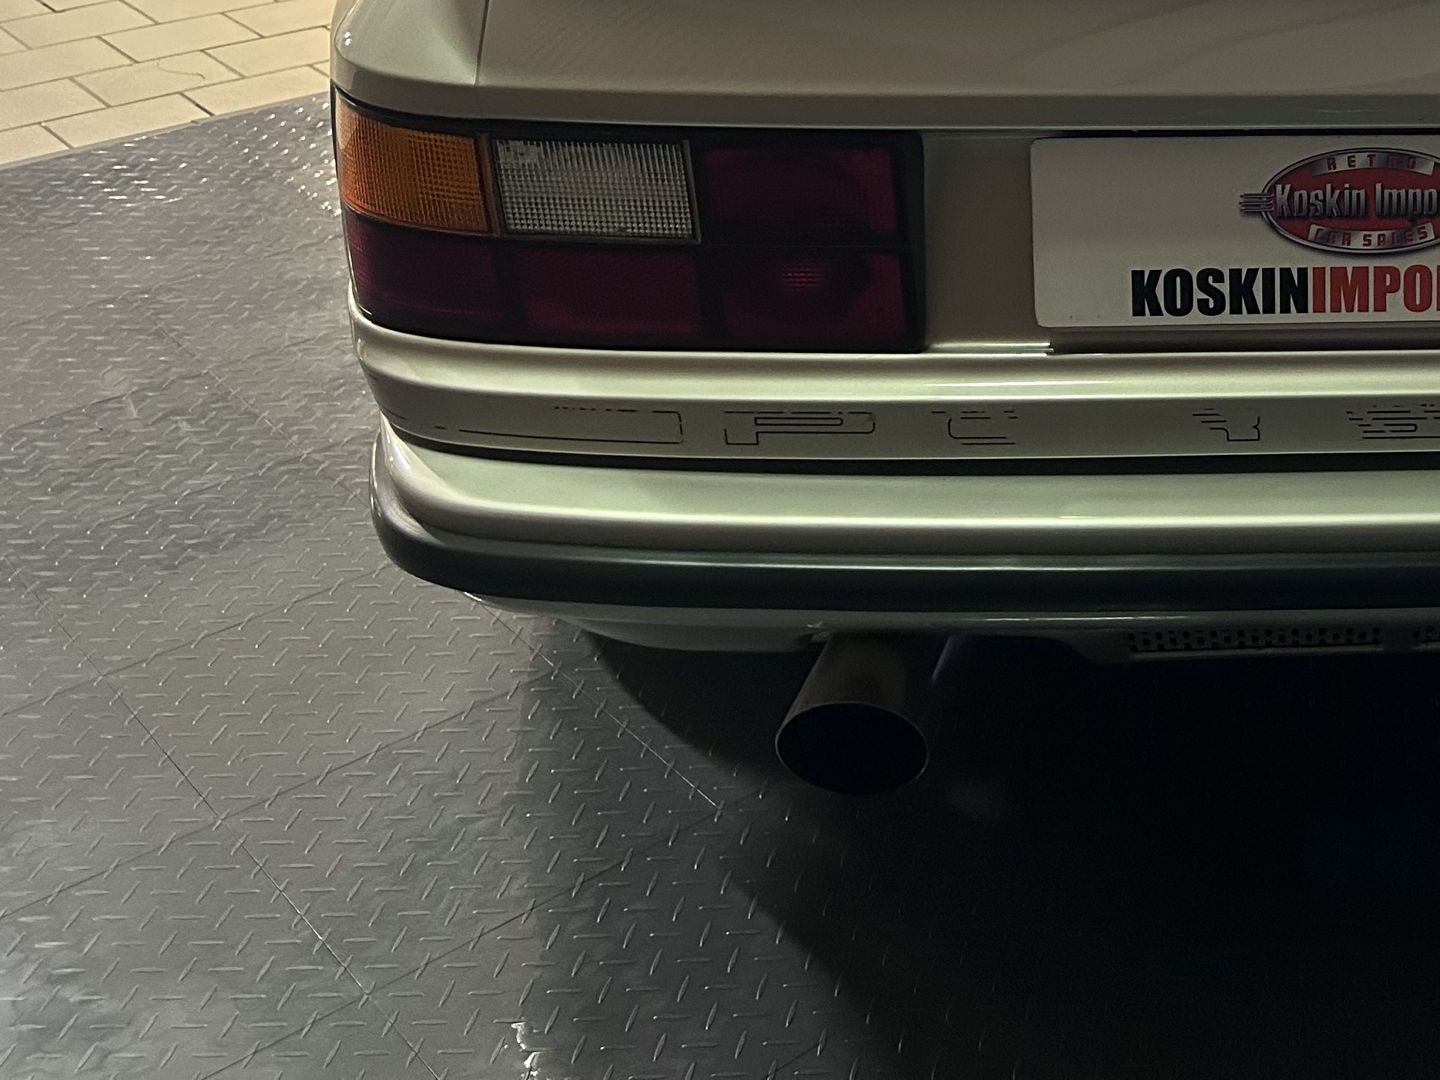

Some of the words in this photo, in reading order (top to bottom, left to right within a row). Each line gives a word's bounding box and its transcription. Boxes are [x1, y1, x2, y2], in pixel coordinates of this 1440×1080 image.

[1326, 153, 1418, 171] RETRO
[1274, 182, 1368, 219] Koskin
[1312, 226, 1352, 246] CAR
[1362, 225, 1429, 247] SALES
